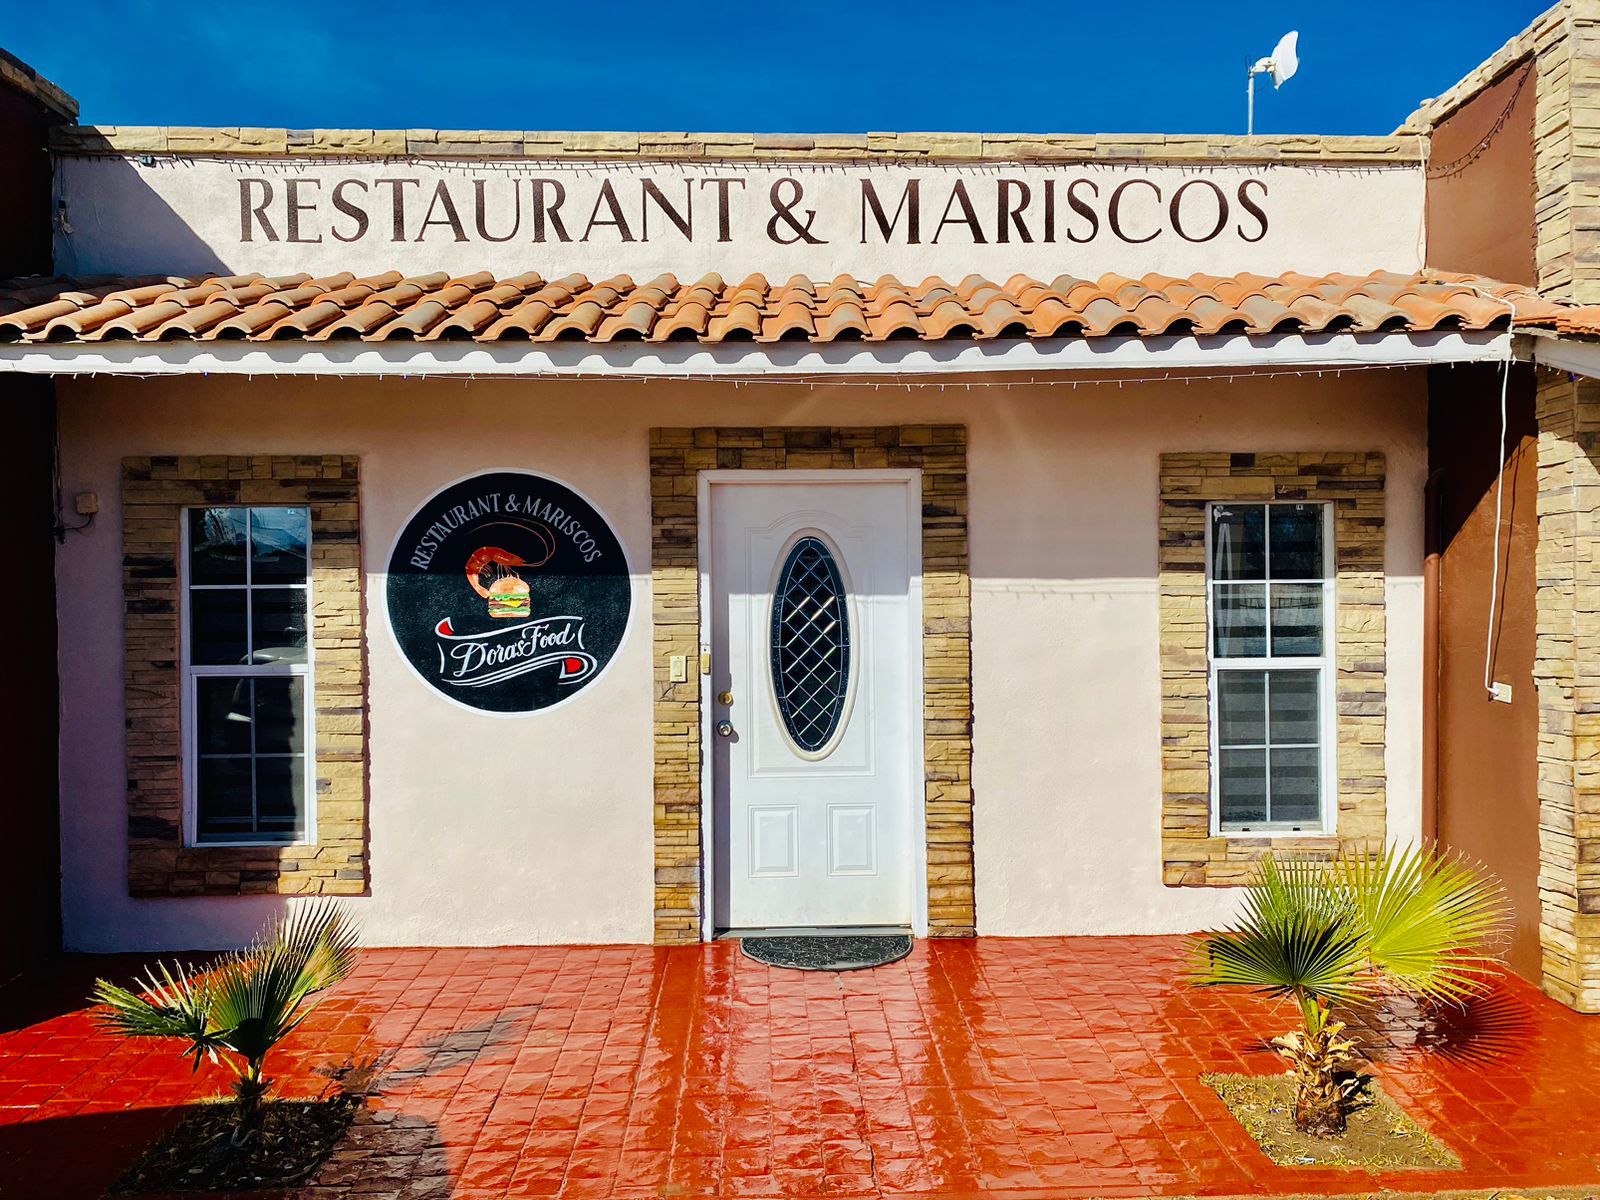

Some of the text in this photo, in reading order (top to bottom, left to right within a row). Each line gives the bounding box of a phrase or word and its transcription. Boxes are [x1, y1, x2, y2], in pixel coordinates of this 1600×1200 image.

[238, 176, 1269, 245] RESTAURANT & MARISCOS
[410, 493, 602, 571] RESTAURANT & MARISCOS
[520, 622, 576, 657] Food
